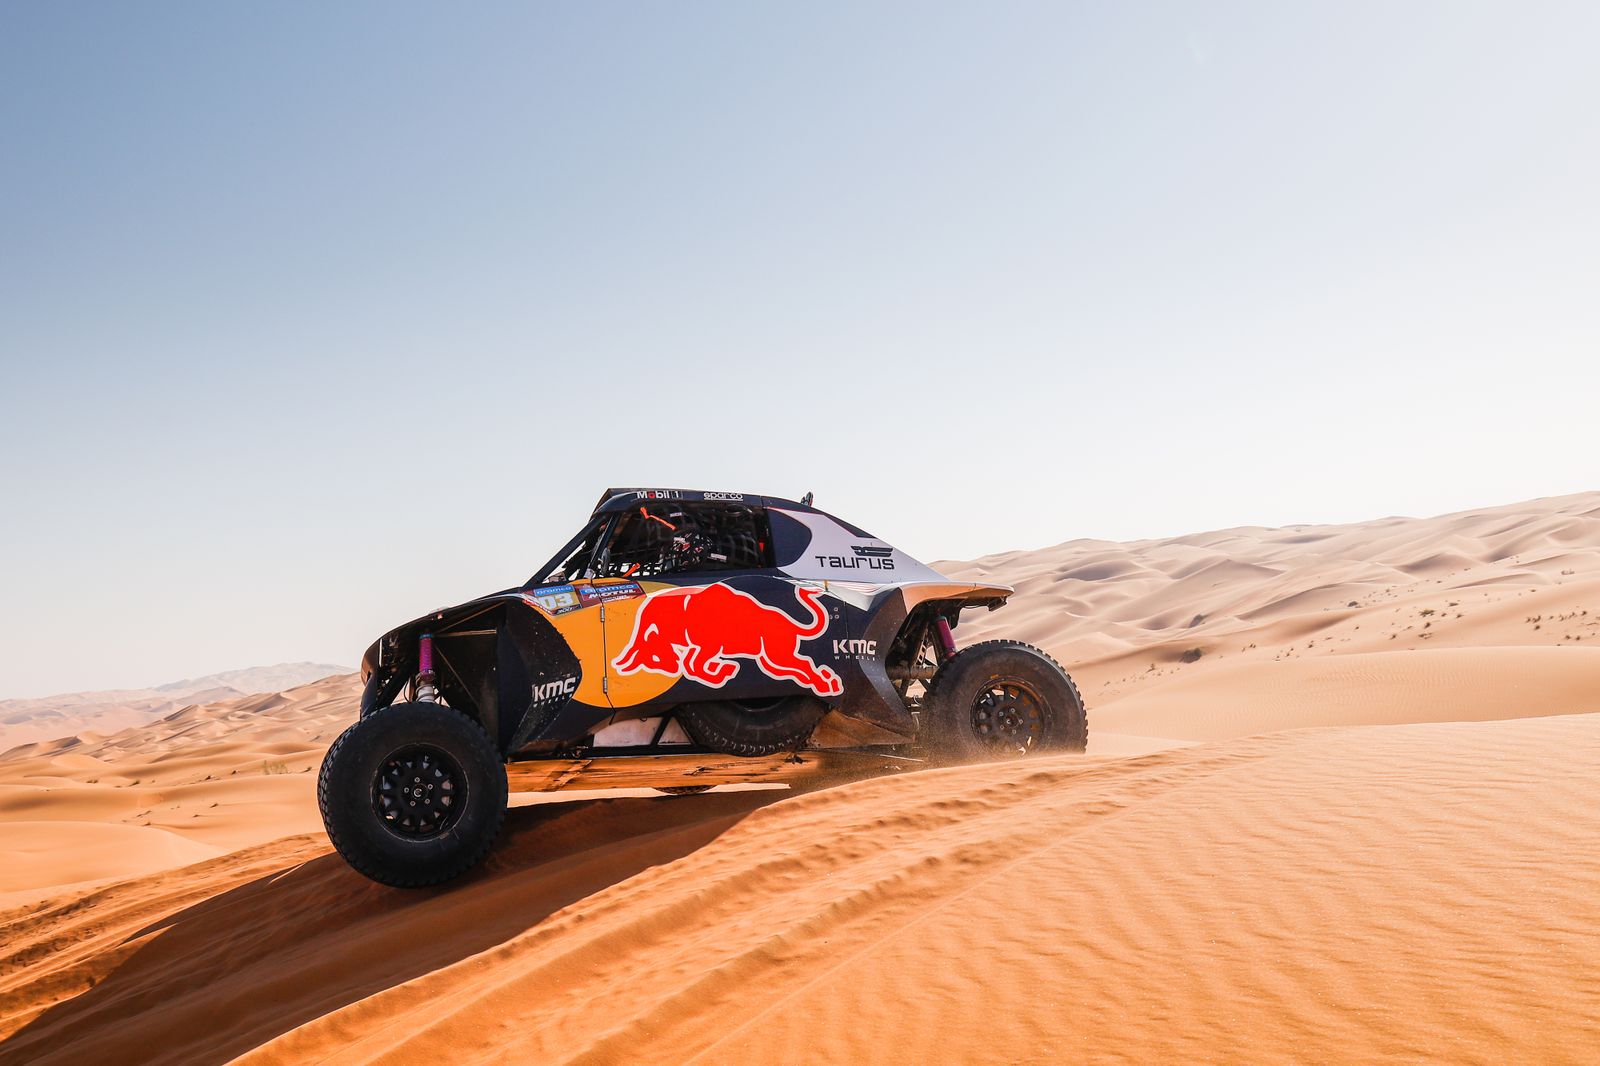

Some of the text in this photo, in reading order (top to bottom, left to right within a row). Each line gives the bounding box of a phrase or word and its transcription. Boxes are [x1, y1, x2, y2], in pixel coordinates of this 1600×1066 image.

[636, 490, 670, 499] Mobil
[704, 492, 744, 501] sparco
[589, 589, 636, 599] MOTUL
[832, 639, 877, 656] KMC
[534, 677, 577, 702] KMC
